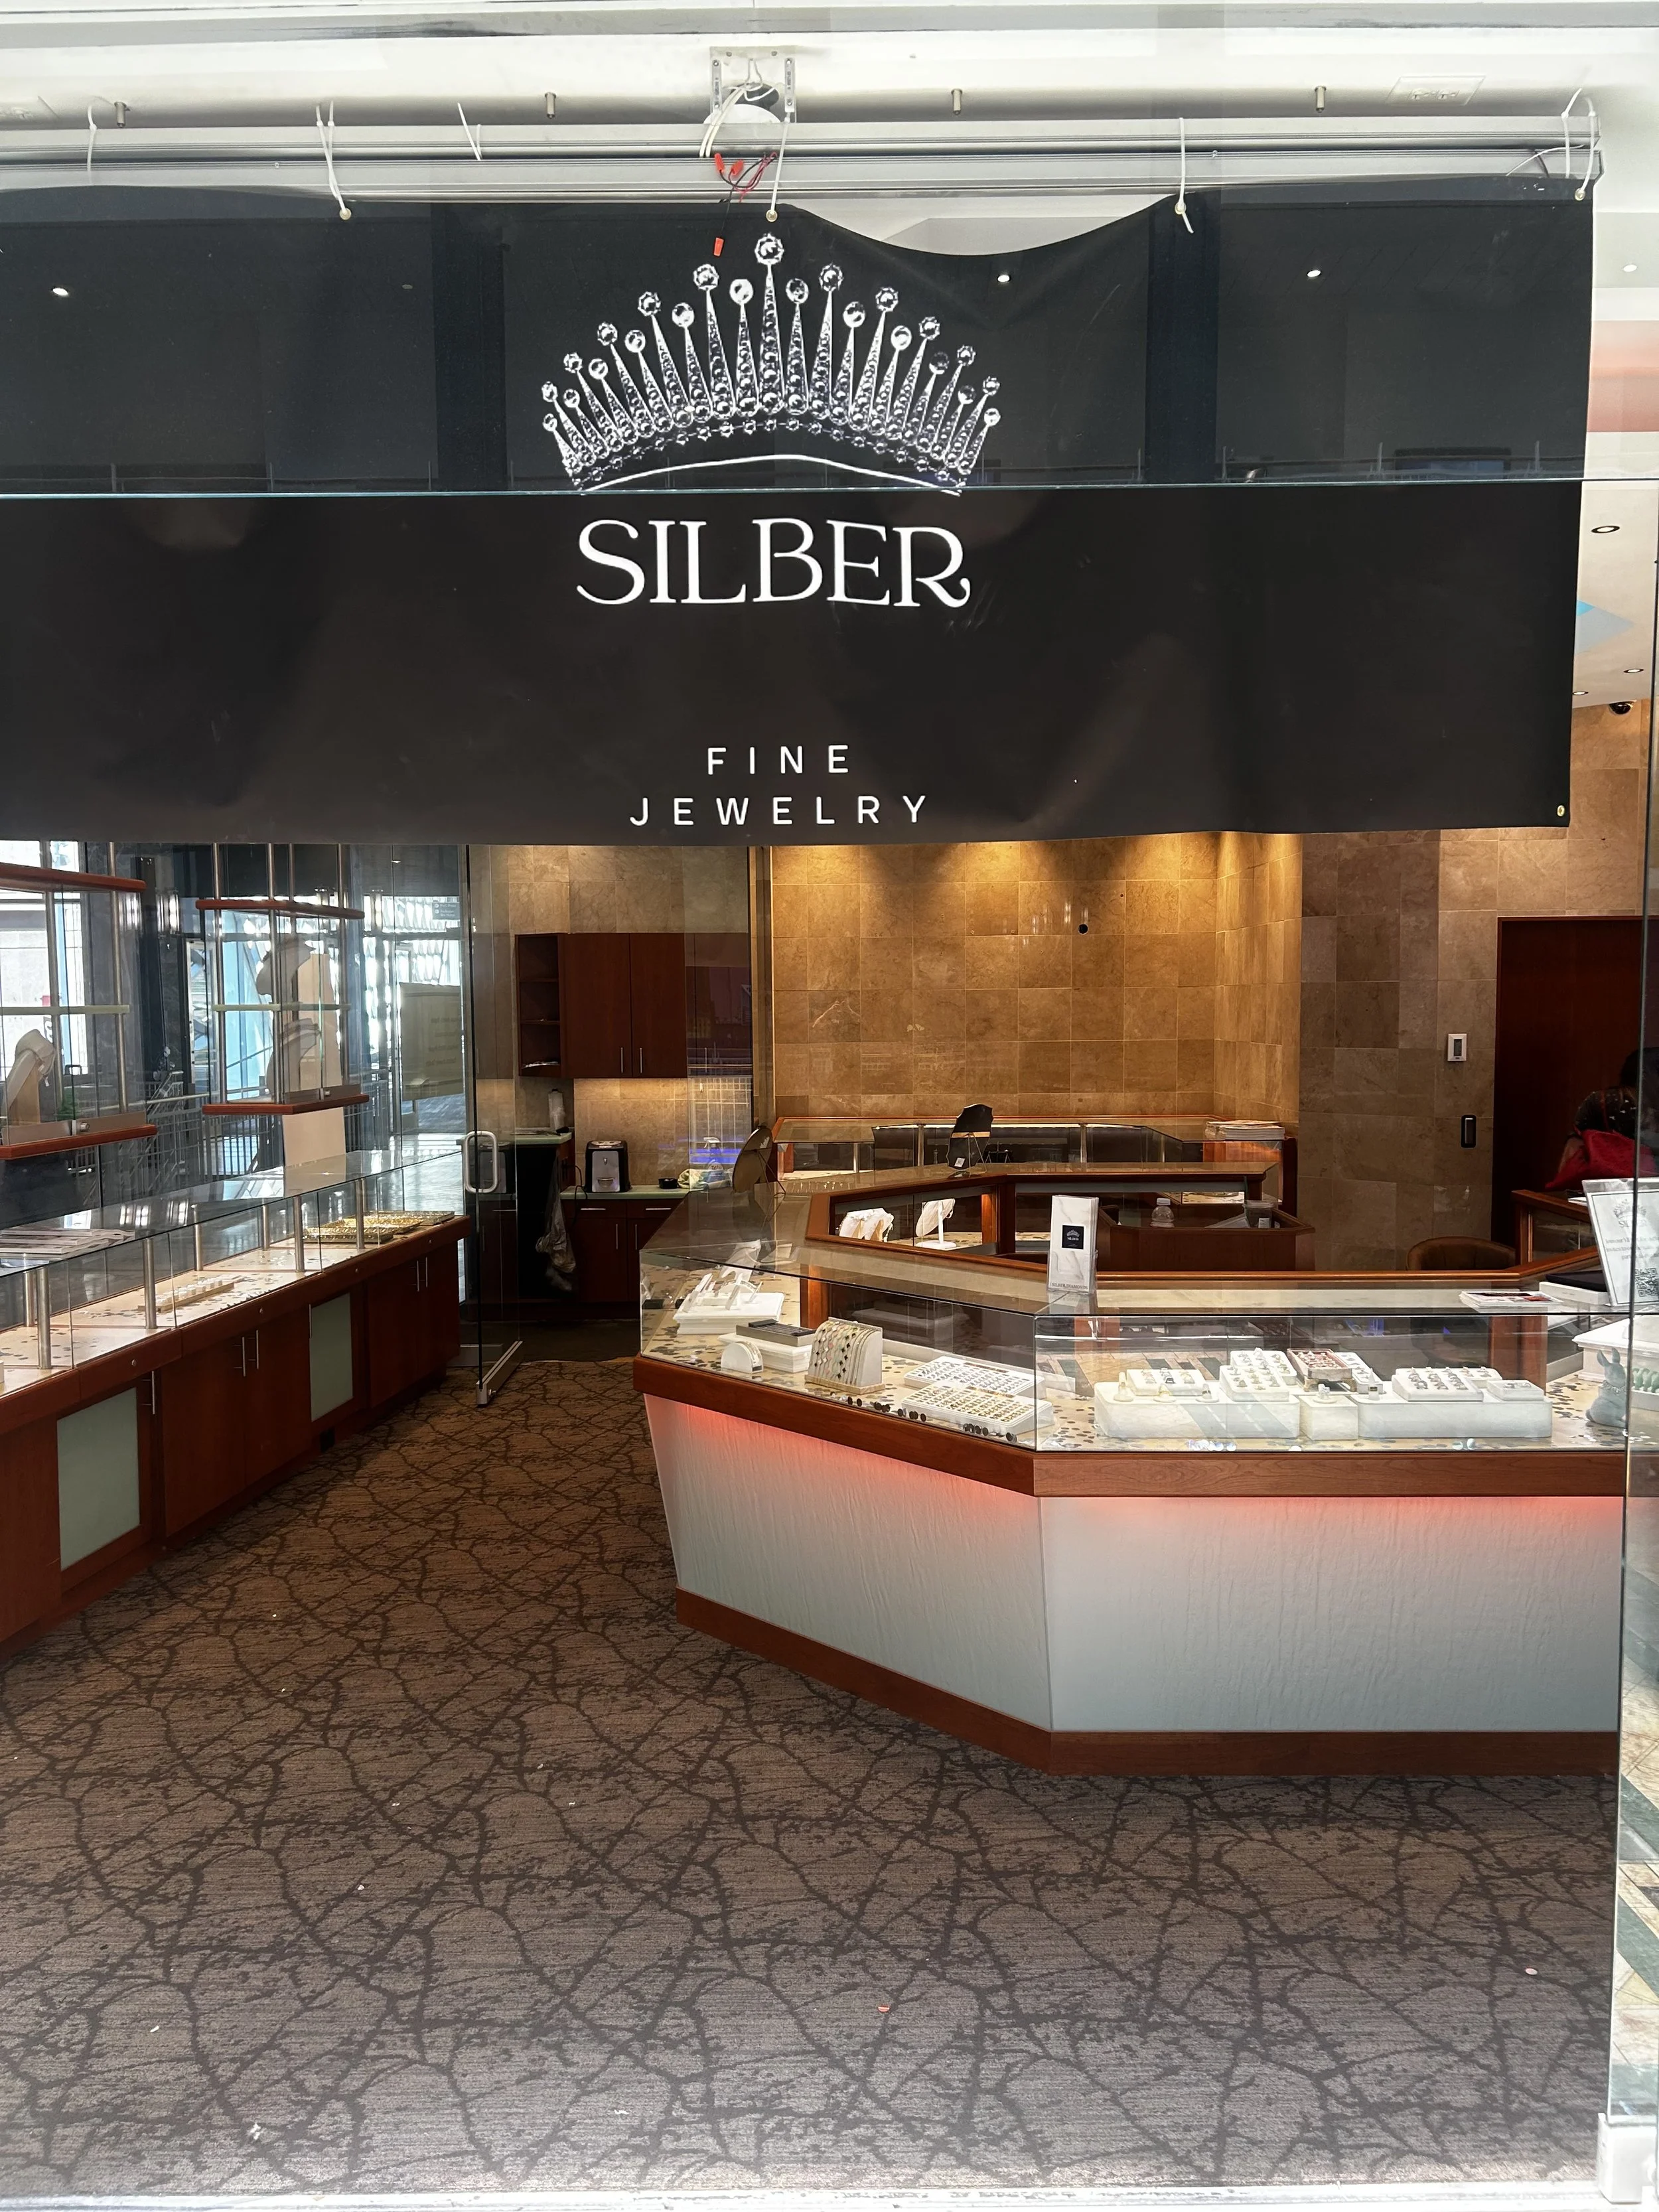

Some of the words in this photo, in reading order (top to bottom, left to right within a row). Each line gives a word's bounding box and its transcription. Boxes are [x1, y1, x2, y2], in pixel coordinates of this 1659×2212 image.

[576, 518, 971, 608] SILBER
[707, 745, 849, 775] FINE
[630, 795, 926, 826] JEWELRY
